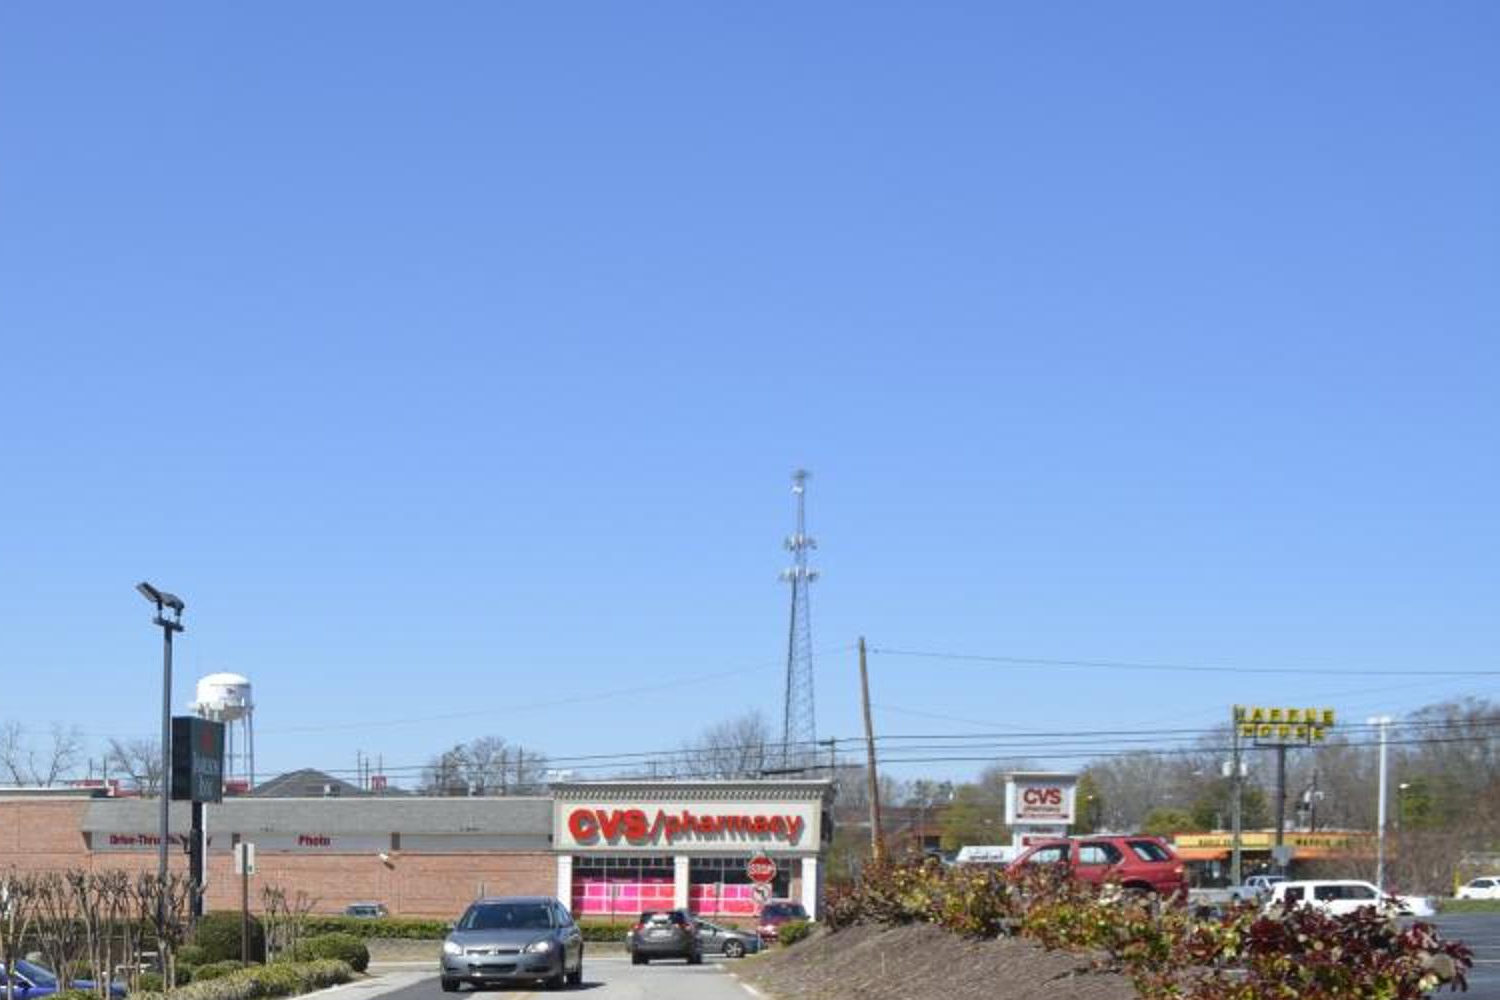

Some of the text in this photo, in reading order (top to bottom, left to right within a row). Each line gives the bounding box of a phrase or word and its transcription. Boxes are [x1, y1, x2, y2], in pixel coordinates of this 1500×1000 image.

[1024, 787, 1061, 804] CVS
[568, 809, 805, 846] CVS/pharmacy
[298, 834, 331, 846] Photo
[750, 863, 774, 874] STOP
